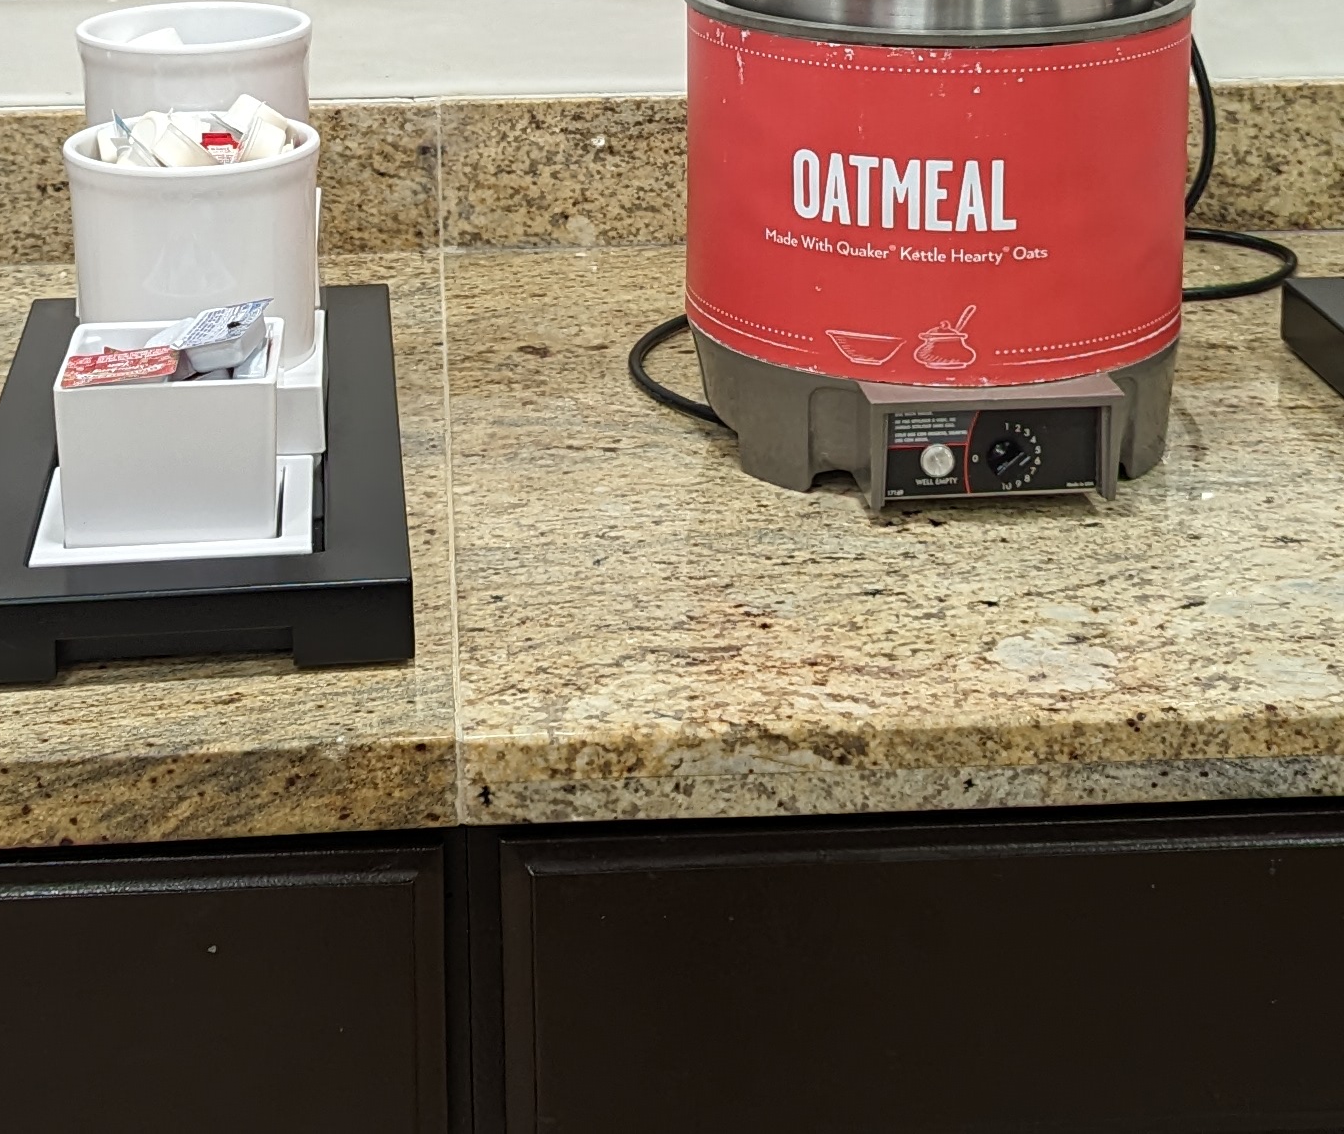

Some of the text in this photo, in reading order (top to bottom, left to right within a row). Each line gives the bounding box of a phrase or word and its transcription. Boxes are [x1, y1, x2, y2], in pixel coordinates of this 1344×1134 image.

[793, 148, 1018, 232] OATMEAL
[765, 228, 798, 247] Made
[800, 235, 833, 253] With
[900, 246, 946, 262] Kettle
[1012, 246, 1048, 260] Oats
[1005, 422, 1009, 431] 1
[1015, 424, 1021, 432] 2
[1024, 428, 1030, 437] 3
[1030, 435, 1036, 444] 4
[1035, 445, 1041, 454] 5
[972, 454, 979, 463] 0
[1034, 456, 1041, 465] 6
[1030, 466, 1036, 475] 7
[1024, 474, 1031, 483] 8
[1001, 482, 1012, 490] 10
[1015, 479, 1022, 488] 9
